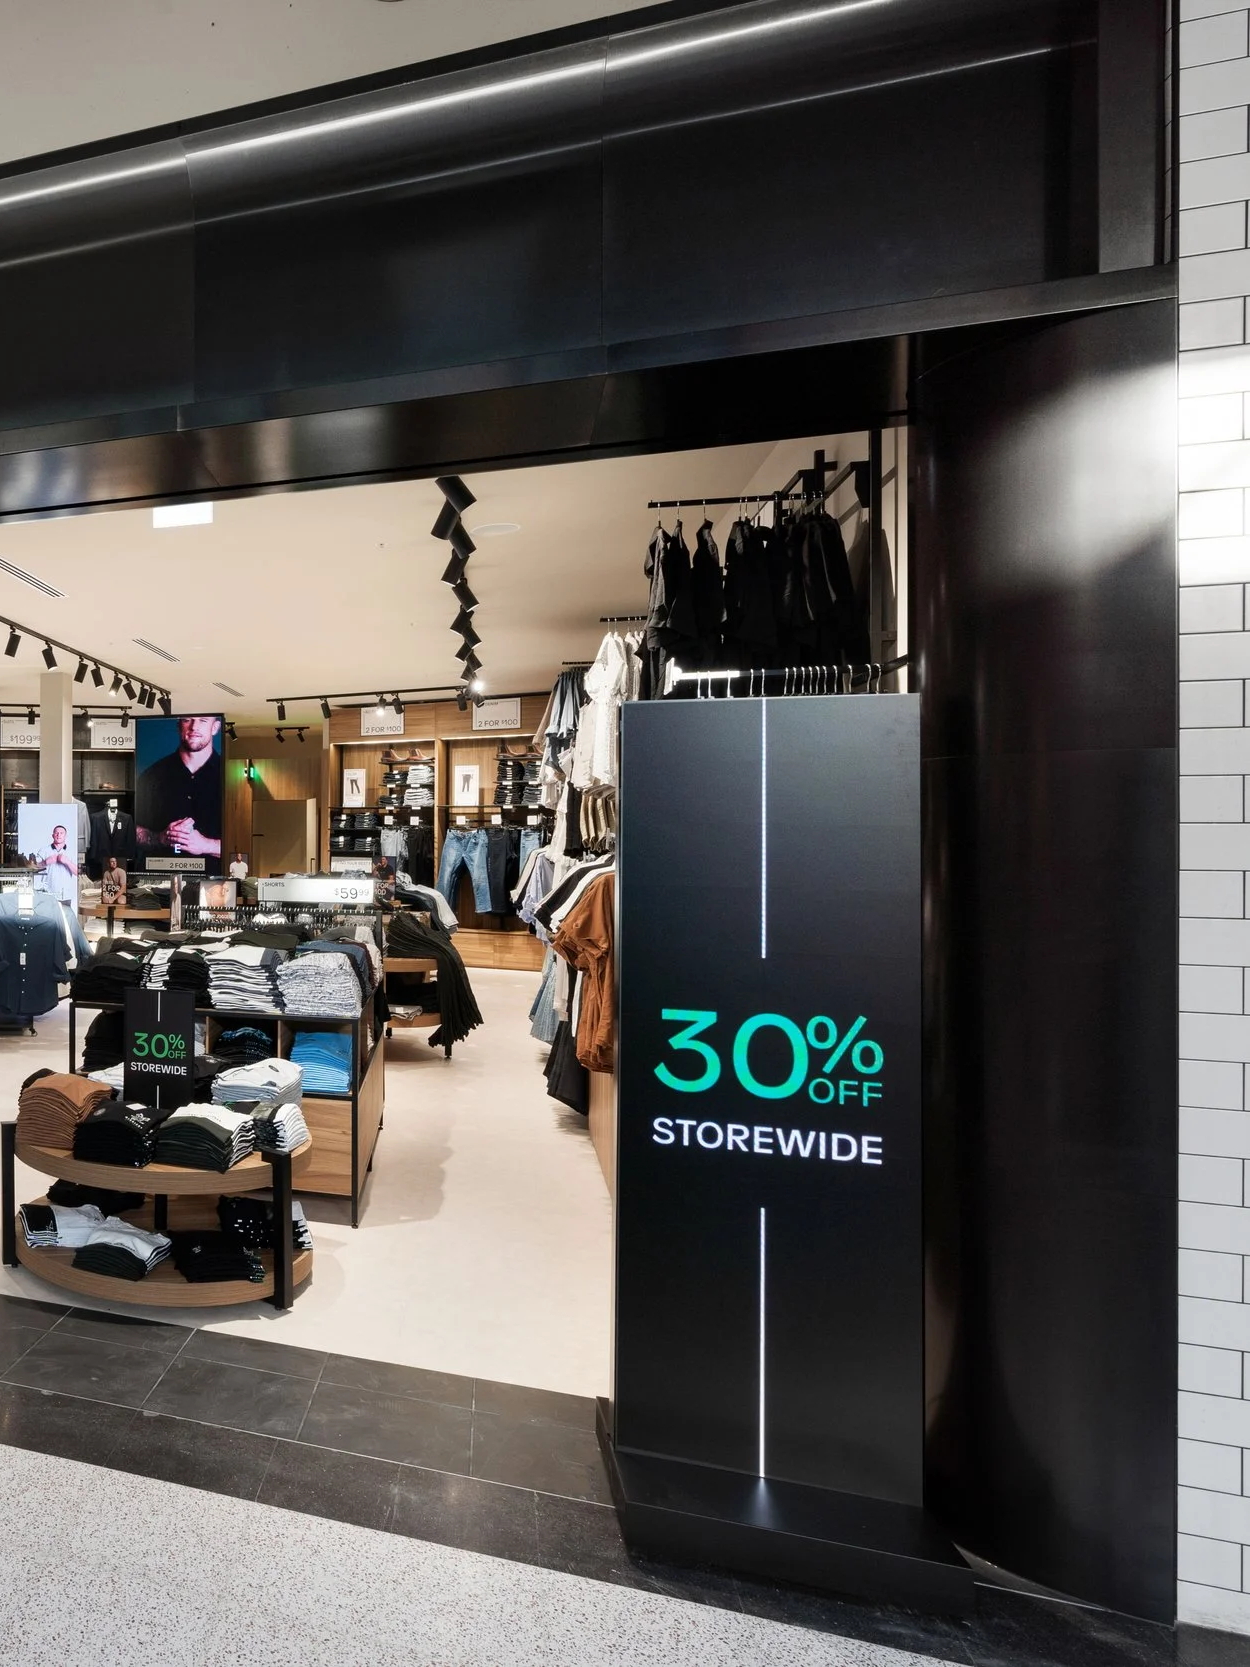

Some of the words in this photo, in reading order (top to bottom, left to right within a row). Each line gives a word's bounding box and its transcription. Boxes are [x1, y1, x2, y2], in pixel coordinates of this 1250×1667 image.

[478, 720, 483, 728] 2
[501, 718, 518, 726] $100
[132, 1032, 185, 1059] 30%
[168, 1050, 187, 1060] OFF
[653, 1008, 884, 1099] 30%
[808, 1078, 883, 1107] OFF
[130, 1061, 187, 1076] STOREWIDE
[652, 1117, 883, 1165] STOREWIDE
